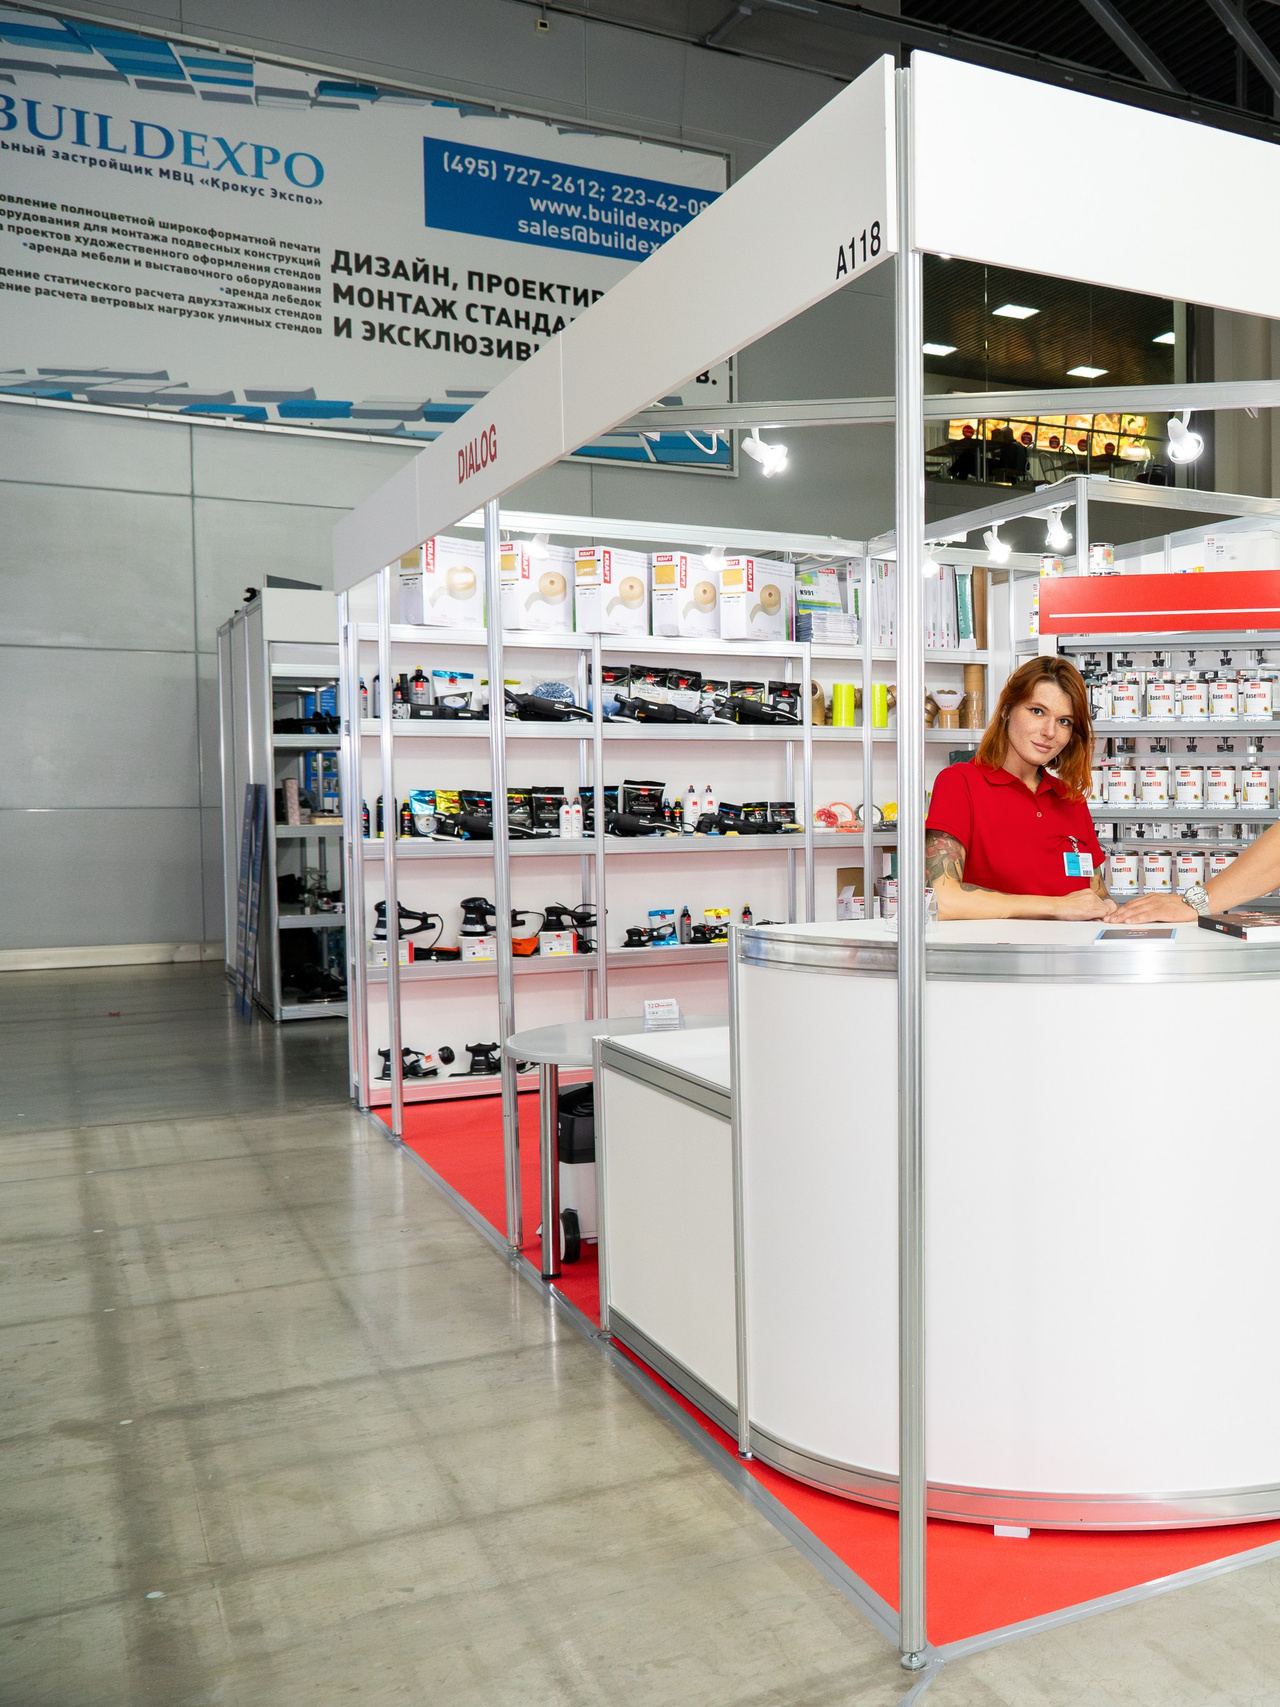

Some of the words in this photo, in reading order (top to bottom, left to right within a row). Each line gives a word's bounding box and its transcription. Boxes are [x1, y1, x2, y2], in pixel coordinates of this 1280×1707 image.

[51, 149, 154, 177] застройщик
[158, 168, 195, 186] МВЦ
[199, 177, 265, 198] «Крокус
[270, 188, 323, 206] Экспо»
[443, 151, 497, 181] (495)
[503, 164, 606, 202] 727-2612;
[7, 223, 71, 242] проектов
[74, 234, 189, 260] художественного
[192, 254, 271, 274] оформления
[273, 267, 321, 281] стендов
[61, 204, 155, 227] полноцветной
[158, 220, 276, 247] широкоформатной
[279, 240, 321, 254] печати
[83, 222, 108, 233] для
[111, 227, 168, 243] монтажа
[171, 236, 241, 255] подвесных
[243, 248, 321, 268] конструкций
[835, 221, 881, 280] A118
[28, 241, 78, 257] аренда
[81, 251, 131, 266] мебели
[134, 258, 141, 267] и
[145, 261, 233, 281] выставочного
[236, 274, 322, 295] оборудования
[330, 249, 458, 291] ДИЗАЙН,
[34, 287, 87, 302] расчета
[91, 295, 154, 311] ветровых
[157, 305, 215, 320] нагрузок
[217, 313, 272, 329] уличных
[274, 321, 323, 335] стендов
[43, 273, 132, 294] статического
[135, 287, 185, 302] расчета
[187, 295, 272, 315] двухэтажных
[274, 308, 323, 321] стендов
[224, 286, 269, 301] аренда
[271, 293, 322, 309] лебедок
[332, 282, 457, 320] МОНТАЖ
[333, 316, 352, 339] И
[458, 424, 498, 484] DIALOG
